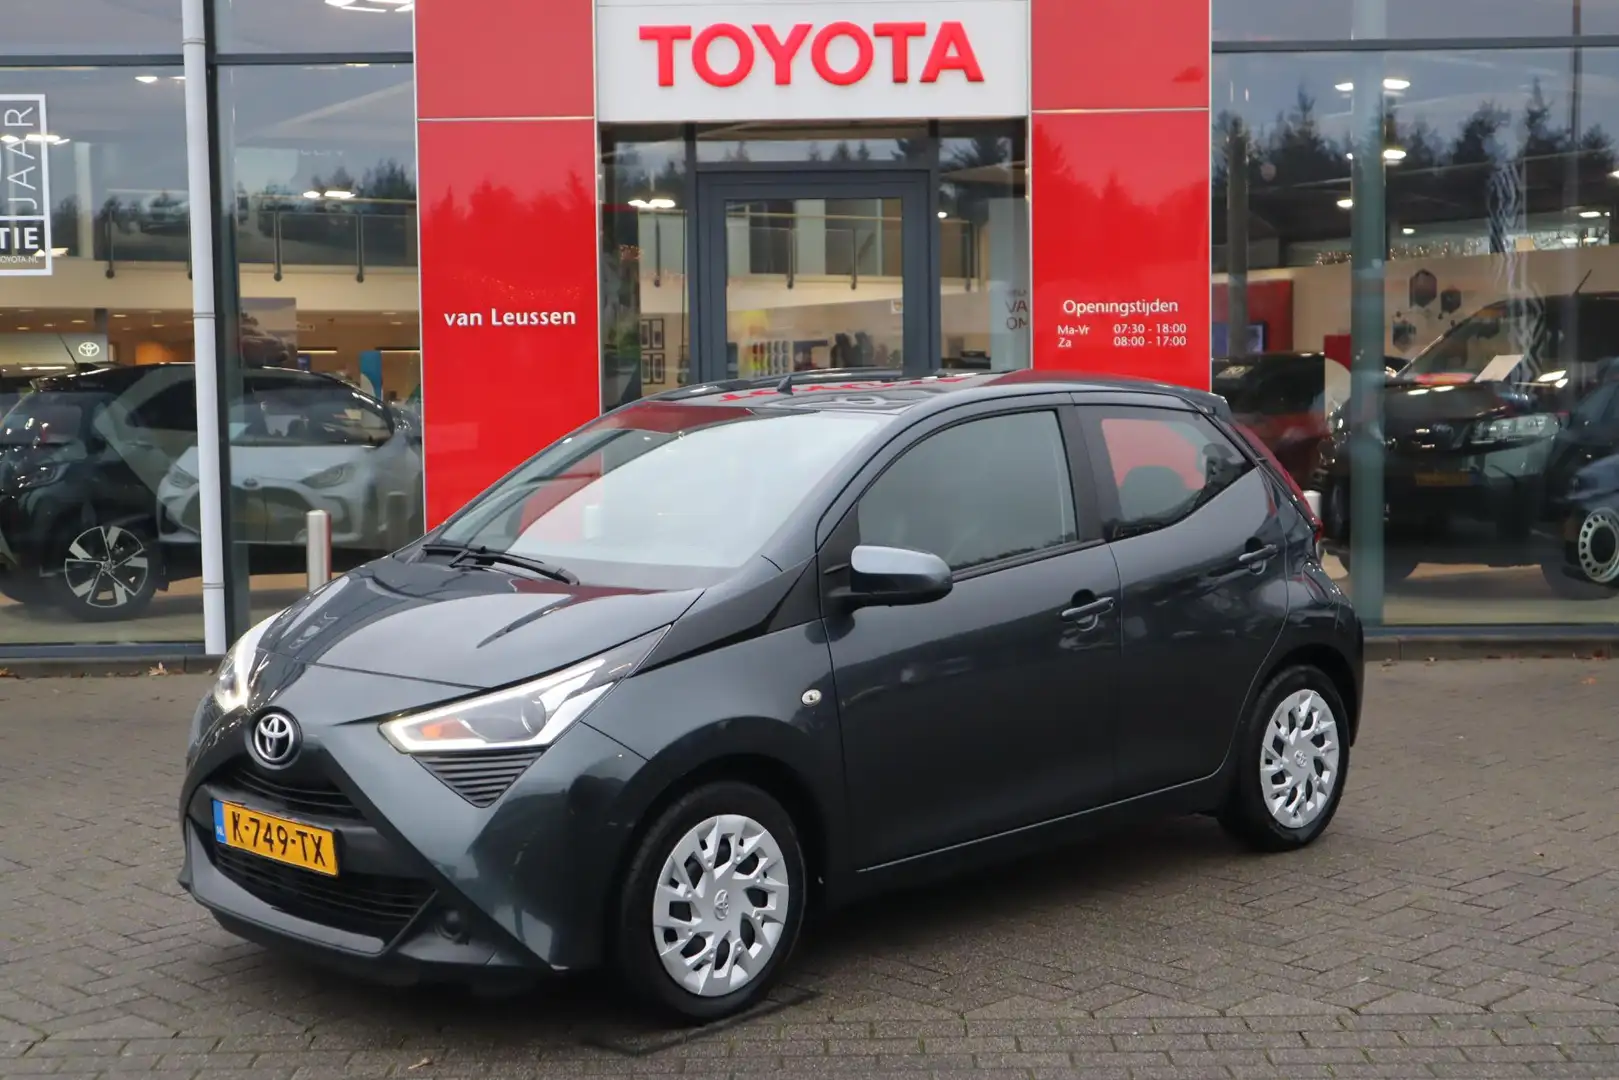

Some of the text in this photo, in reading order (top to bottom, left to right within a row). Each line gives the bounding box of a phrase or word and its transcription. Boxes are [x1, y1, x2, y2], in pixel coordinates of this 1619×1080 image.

[639, 21, 985, 87] TOYOTA
[4, 106, 38, 210] JAAR
[443, 308, 576, 326] van Leussen
[1062, 299, 1179, 317] Openingstijden
[1057, 324, 1090, 335] Ma-Vr
[1113, 323, 1145, 334] 07:30
[1156, 323, 1187, 334] 18:00
[1058, 337, 1072, 348] Za
[1113, 336, 1145, 347] 08:00
[1156, 336, 1187, 347] 17:00
[231, 811, 326, 867] K-749-TX
